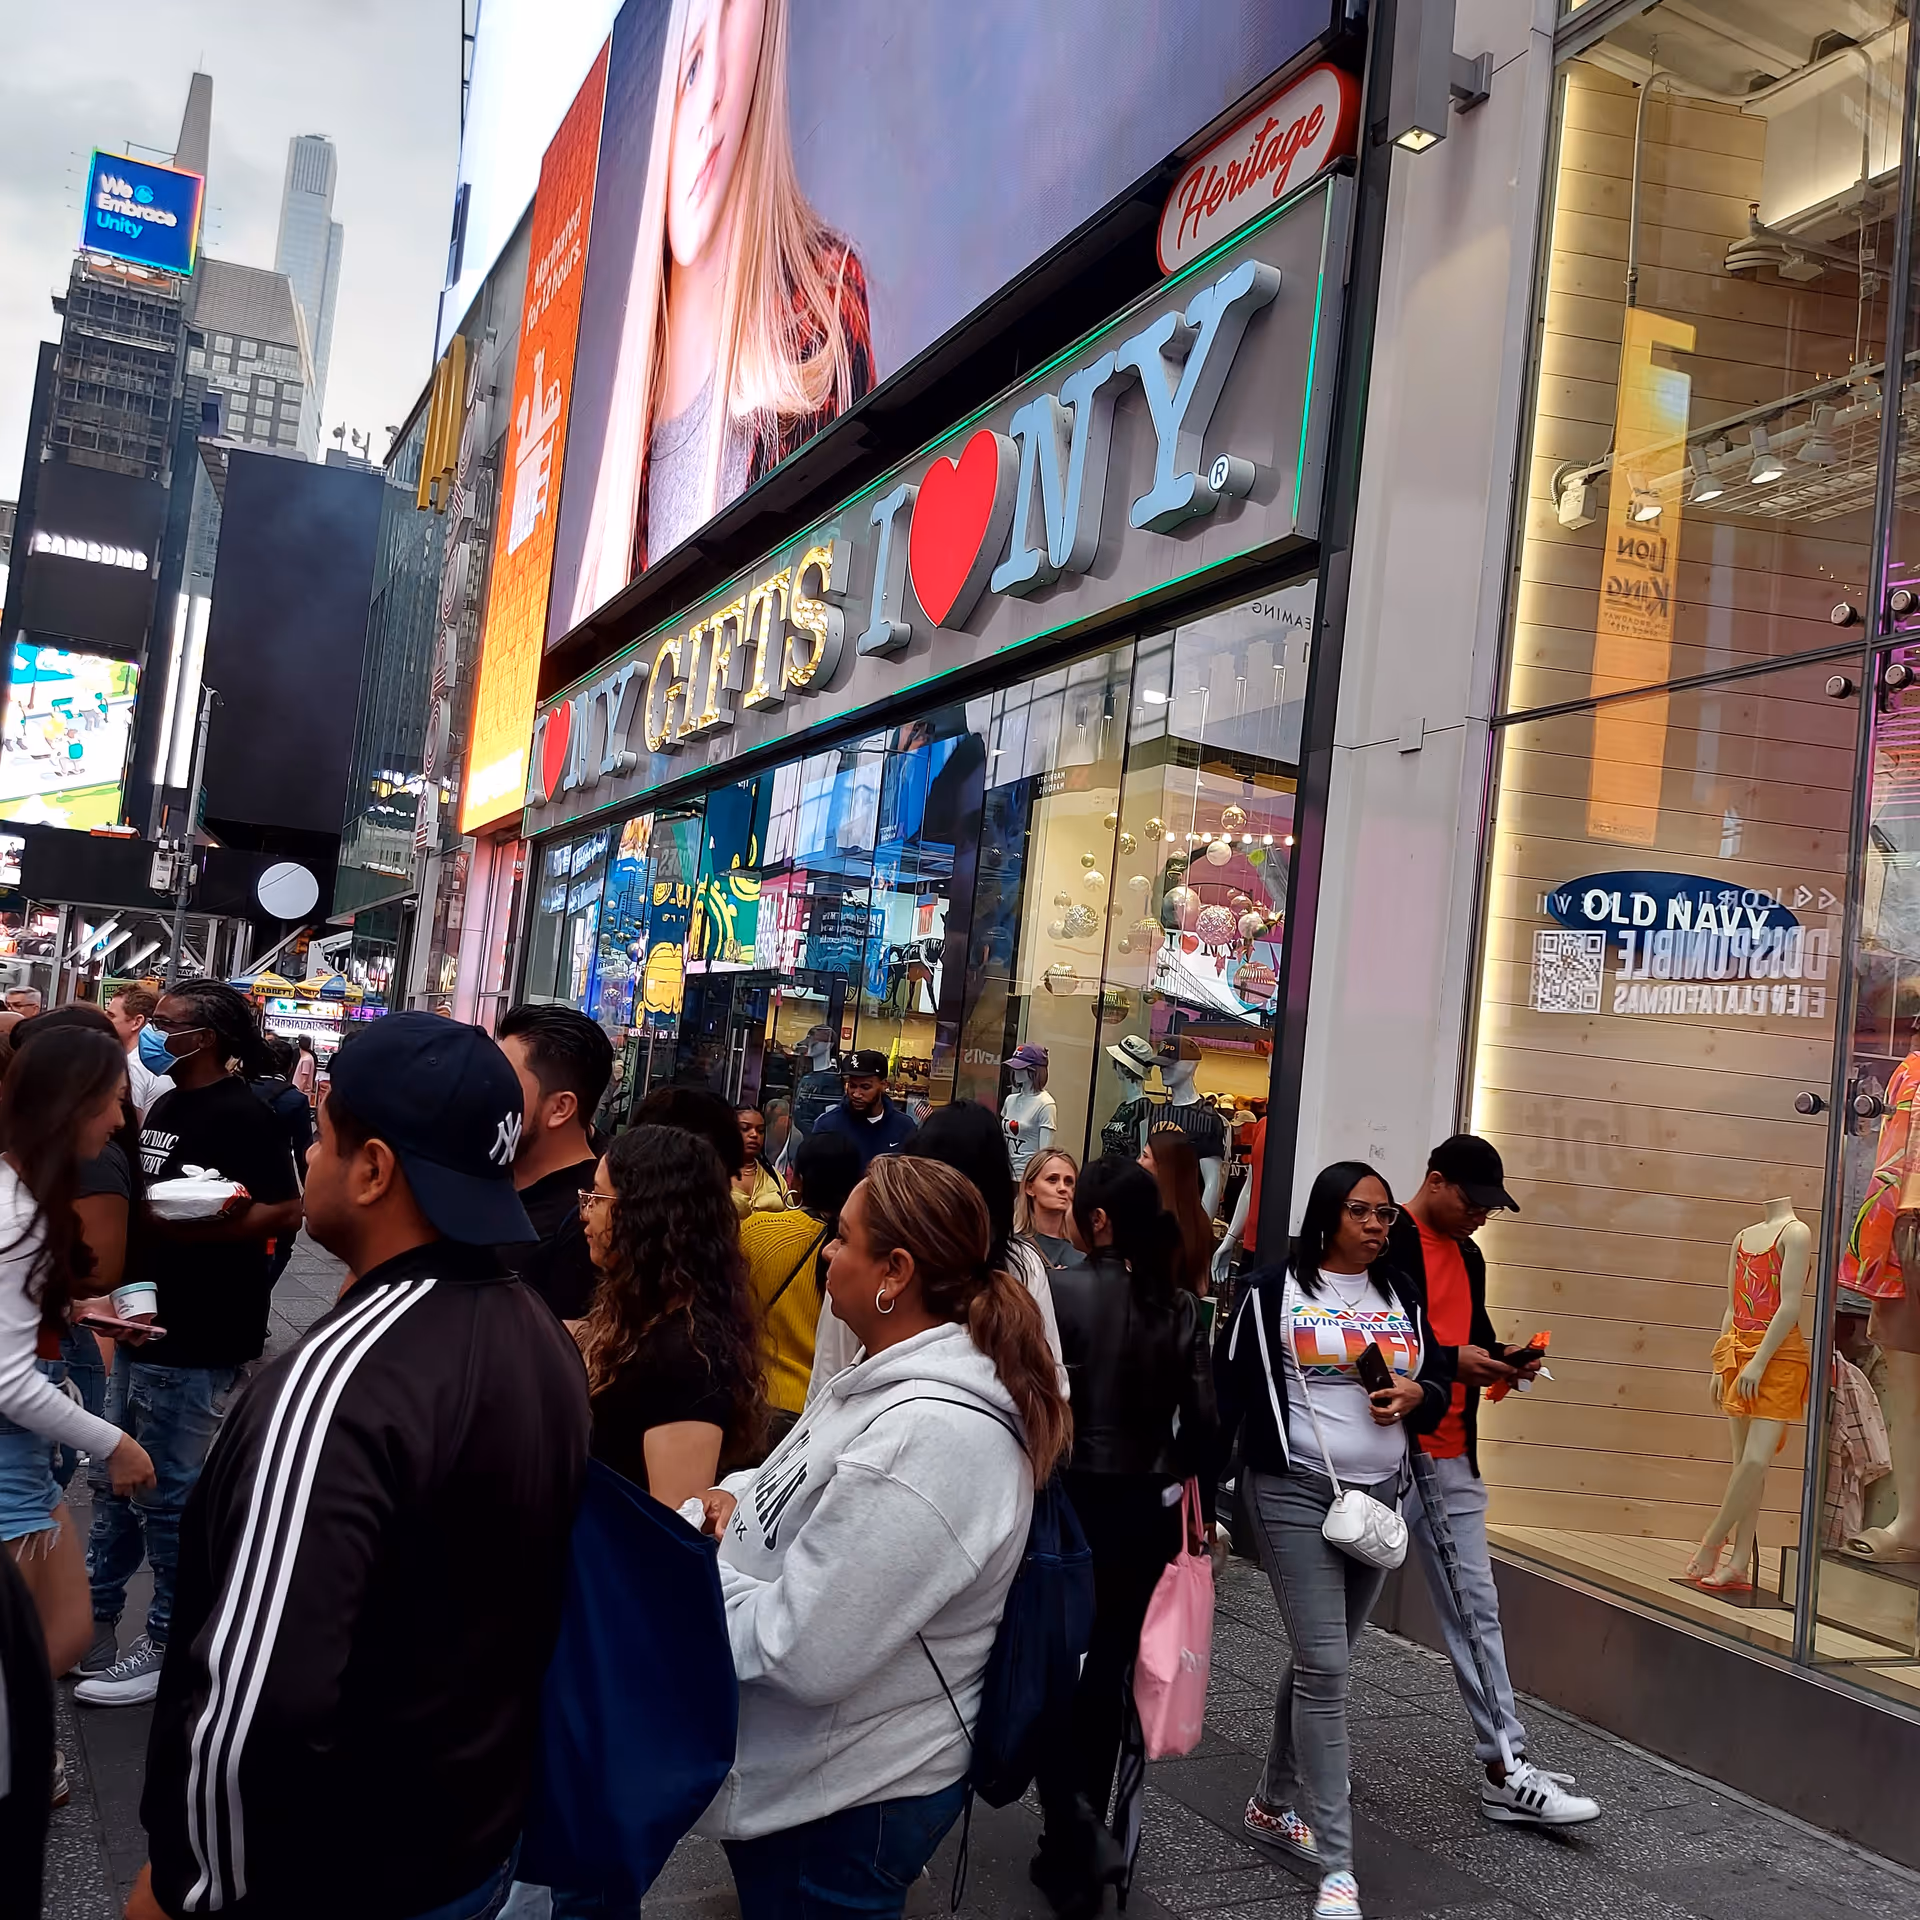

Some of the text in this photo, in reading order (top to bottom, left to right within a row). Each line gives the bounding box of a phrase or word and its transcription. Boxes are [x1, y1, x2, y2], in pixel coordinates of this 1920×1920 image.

[100, 173, 134, 199] We
[1177, 103, 1326, 250] Heritage
[96, 210, 144, 239] Unity
[97, 192, 178, 228] Embrace
[525, 298, 541, 337] for
[857, 259, 1257, 657] I NY
[36, 530, 148, 571] SAMSUNG
[644, 538, 834, 754] GIFTS
[1583, 888, 1770, 940] OLD NAVY
[1293, 1316, 1415, 1332] LIVING MY BES
